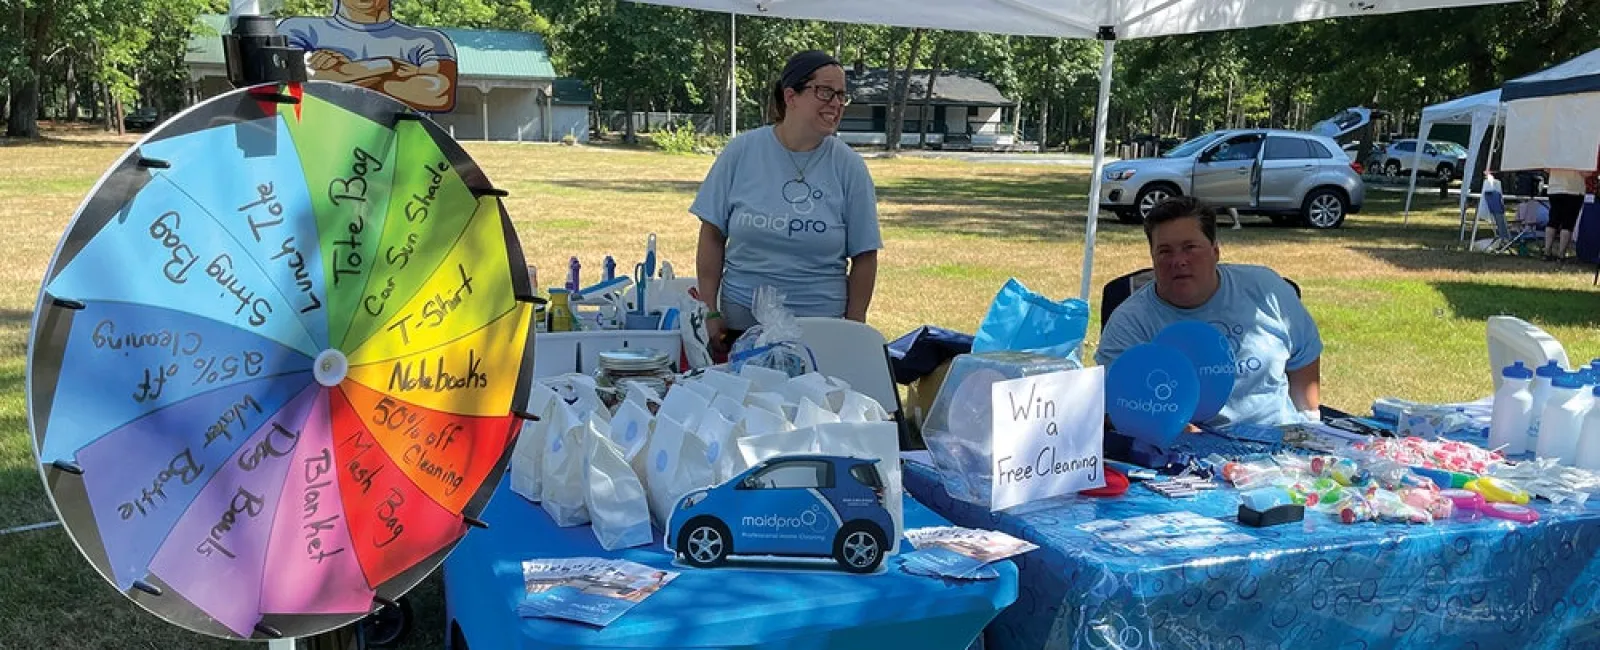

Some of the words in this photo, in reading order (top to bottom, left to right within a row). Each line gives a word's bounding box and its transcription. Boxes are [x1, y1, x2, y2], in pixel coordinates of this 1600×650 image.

[328, 146, 383, 207] Bag
[149, 210, 199, 284] Bag
[332, 215, 364, 288] Tote
[364, 276, 396, 316] Car
[386, 233, 419, 270] Sun
[404, 161, 450, 224] Shade
[736, 211, 827, 238] maidpro
[204, 252, 273, 327] String
[269, 236, 321, 314] Lunch
[387, 263, 473, 346] T-Shirt
[92, 319, 203, 358] Cleaning
[132, 363, 179, 403] off
[191, 350, 264, 387] 25%
[388, 348, 488, 393] Notebooks
[203, 393, 264, 449] Water
[372, 396, 425, 440] 50%
[425, 422, 465, 451] off
[1008, 382, 1056, 422] Win
[1045, 421, 1059, 437] a
[1116, 398, 1179, 416] maidpro
[237, 420, 302, 472] Dog
[402, 444, 464, 497] Cleaning
[997, 455, 1033, 486] Free
[1035, 446, 1099, 482] Cleaning
[117, 447, 206, 521] Bottle
[303, 447, 345, 564] Blanket
[338, 430, 385, 496] Mesh
[372, 487, 406, 548] Bag
[196, 485, 265, 559] Bowls
[741, 513, 801, 532] maidpro
